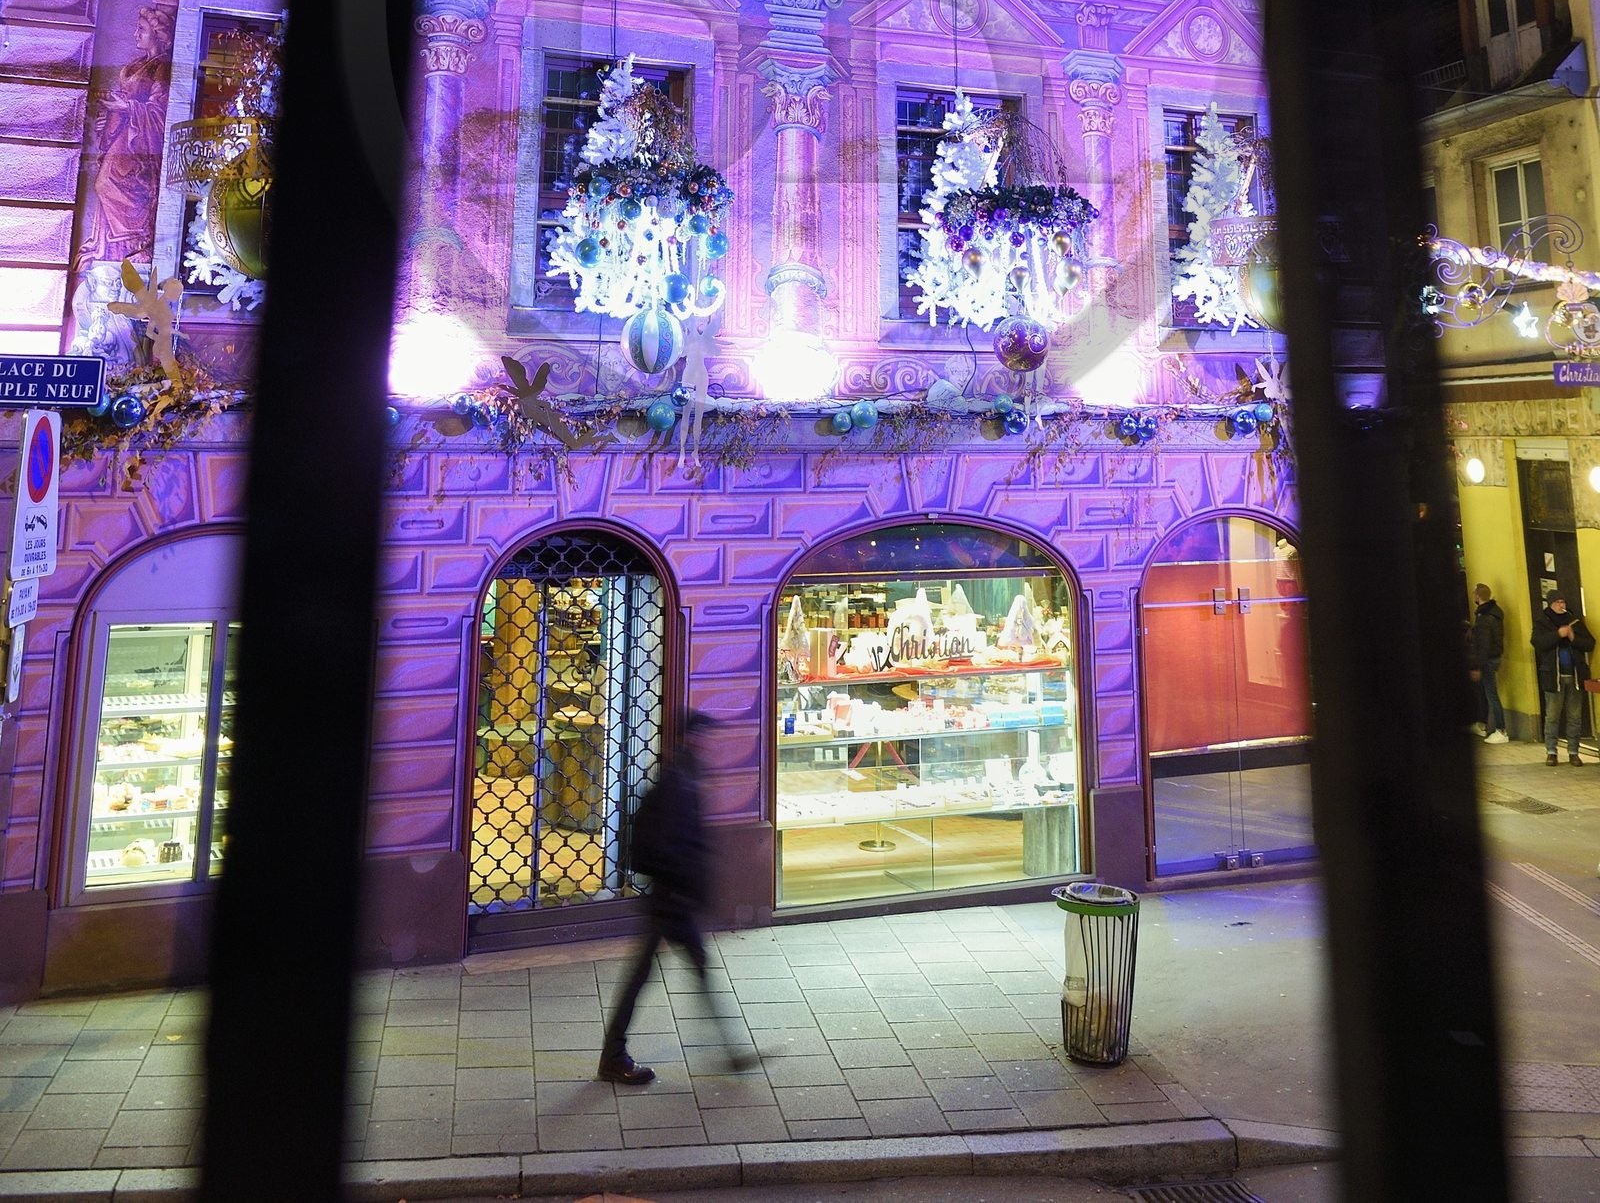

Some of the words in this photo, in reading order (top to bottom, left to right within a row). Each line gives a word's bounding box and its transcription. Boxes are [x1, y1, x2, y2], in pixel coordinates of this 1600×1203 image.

[52, 363, 77, 378] DU
[0, 382, 38, 397] PLE
[45, 383, 94, 399] NEUF
[25, 540, 33, 550] LES
[34, 539, 46, 548] JOURS
[24, 551, 46, 563] OUVRABLES
